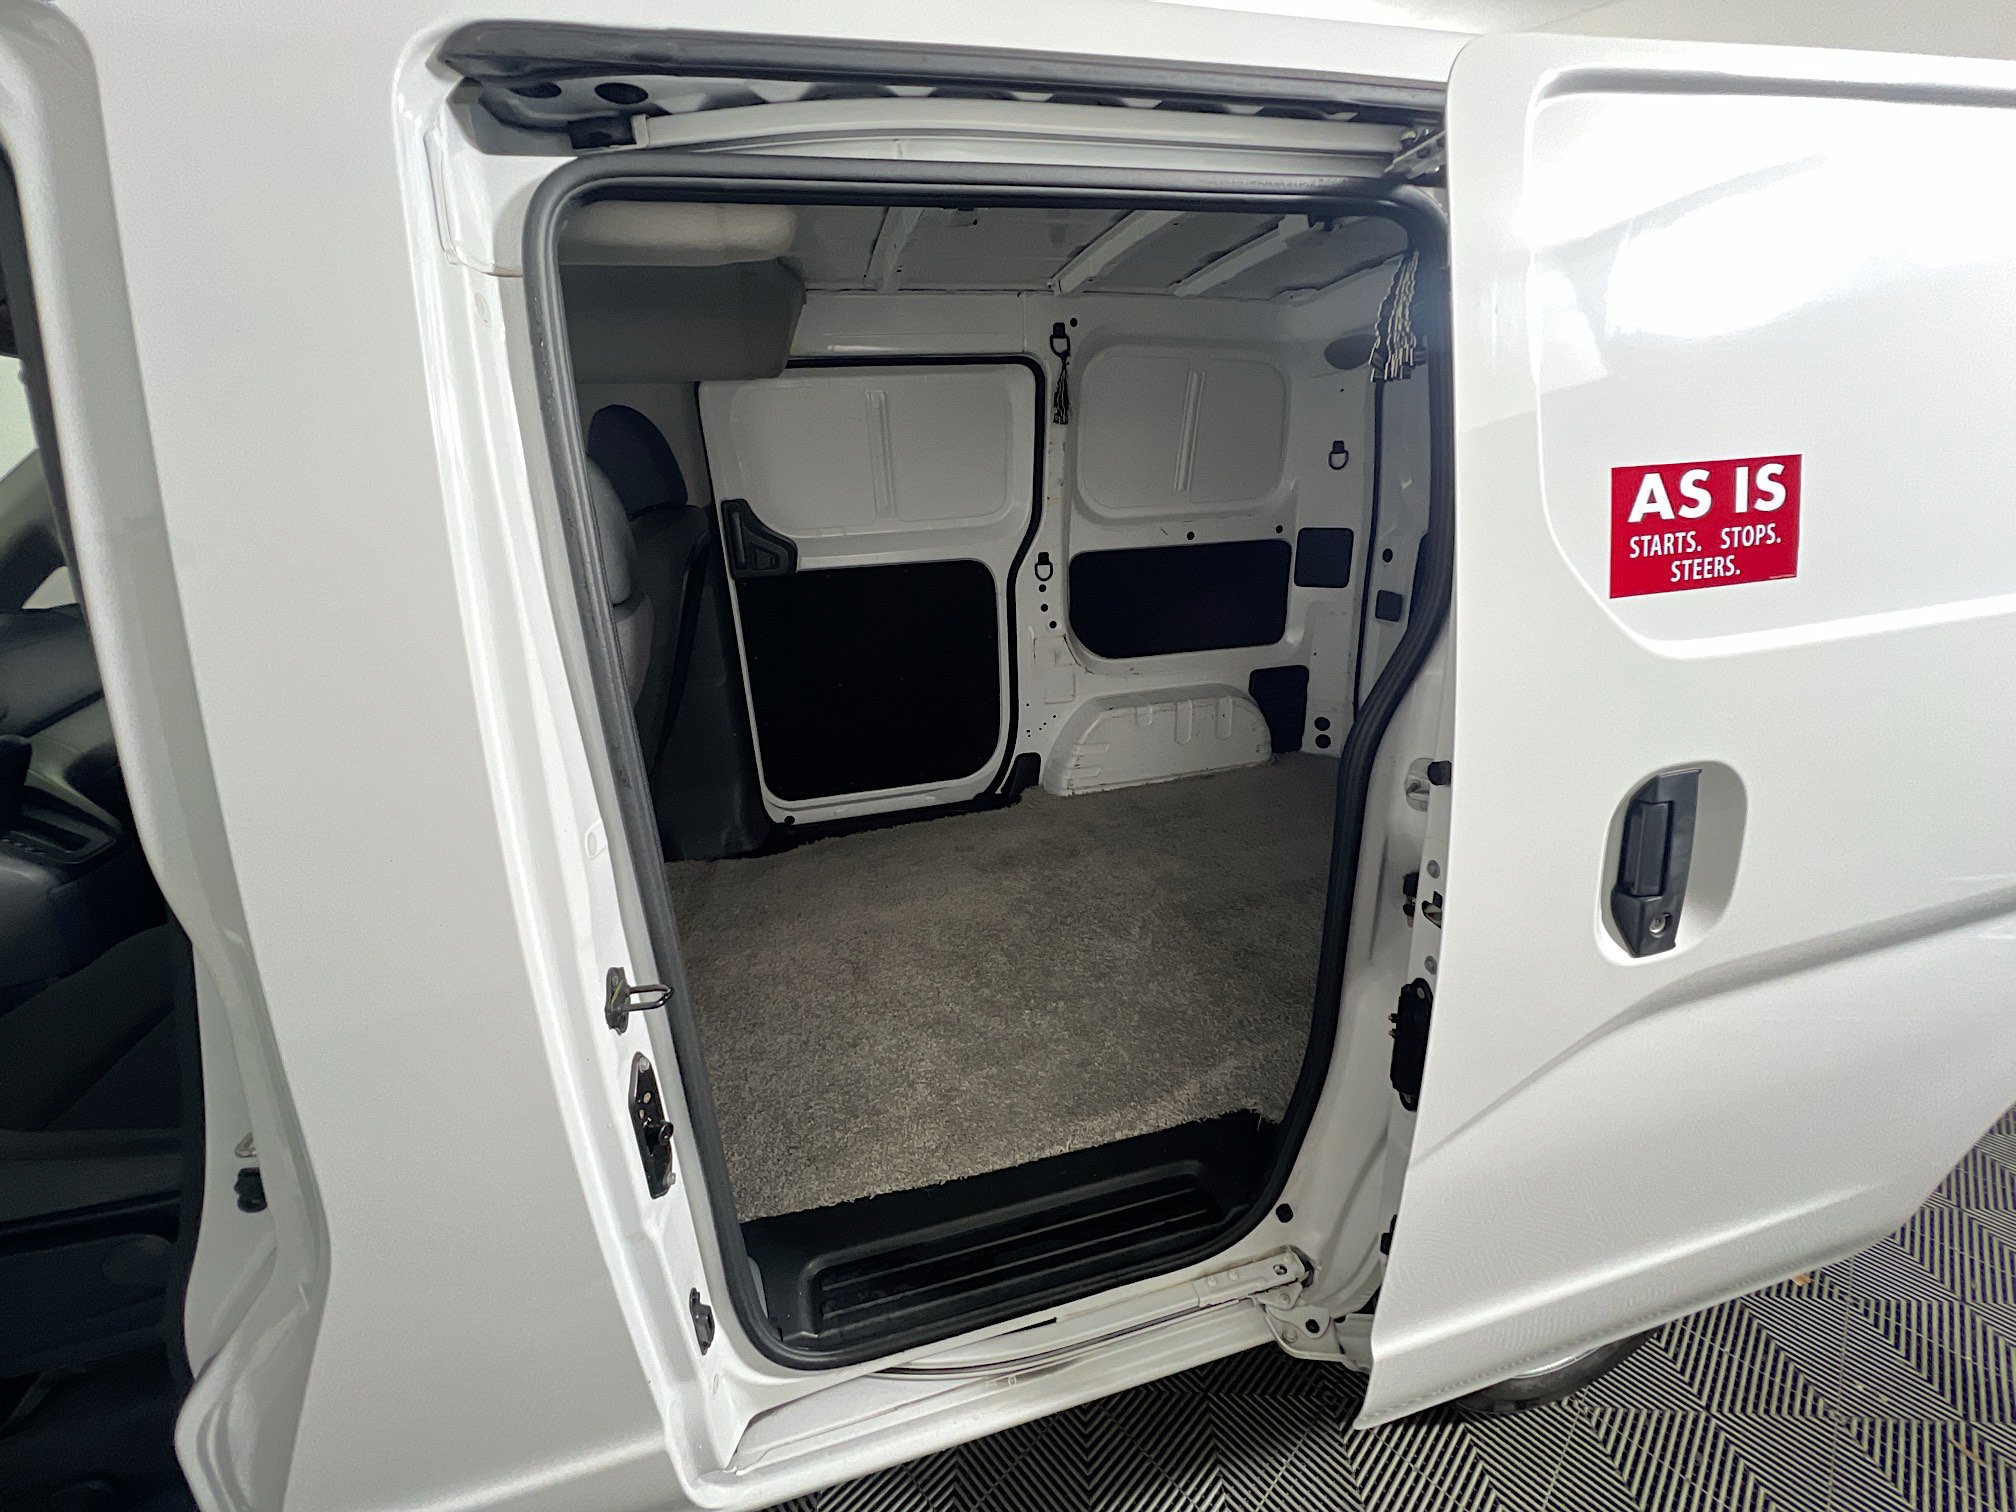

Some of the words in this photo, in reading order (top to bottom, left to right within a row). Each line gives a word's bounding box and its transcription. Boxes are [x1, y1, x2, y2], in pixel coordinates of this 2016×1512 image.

[1627, 468, 1712, 523] AS
[1735, 463, 1787, 513] IS
[1629, 530, 1702, 558] STARTS.
[1721, 522, 1782, 549] STOPS.
[1670, 554, 1741, 582] STEERS.
